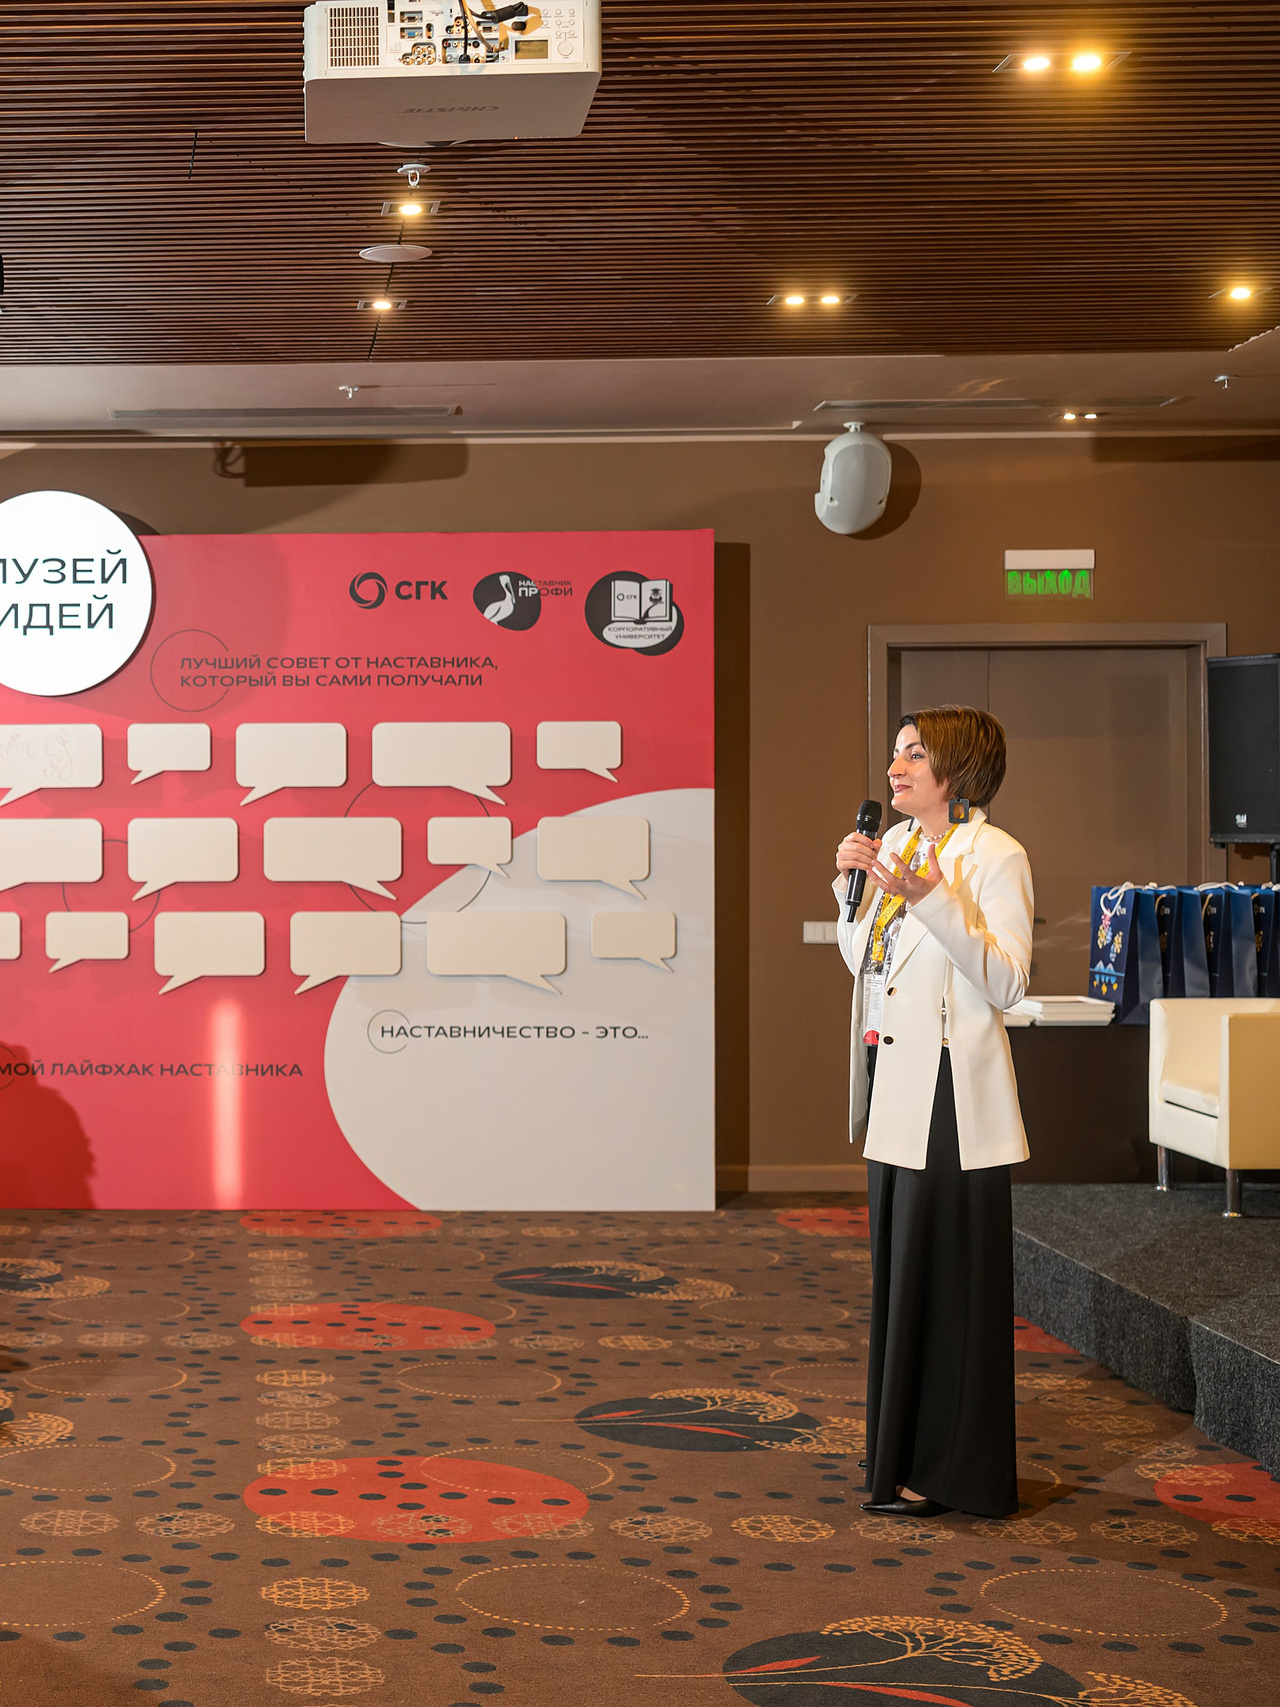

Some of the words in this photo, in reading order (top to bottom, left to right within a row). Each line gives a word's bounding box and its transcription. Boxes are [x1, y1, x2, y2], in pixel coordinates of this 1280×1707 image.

[402, 105, 500, 114] CHRISTIE
[394, 580, 449, 600] СГК
[518, 579, 572, 587] НАСТАВНИК
[1007, 569, 1091, 598] ВЫХОД
[518, 587, 573, 598] ПРОФИ
[179, 654, 262, 670] ЛУЧШИЙ
[266, 656, 332, 669] СОВЕТ
[335, 656, 363, 669] ОТ
[366, 656, 499, 671] НАСТАВНИКА,
[179, 672, 277, 688] КОТОРЫЙ
[282, 675, 311, 687] ВЫ
[315, 674, 372, 687] САМИ
[376, 674, 483, 687] ПОЛУЧАЛИ
[882, 900, 898, 920] 2026
[380, 1025, 576, 1039] НАСТАВНИЧЕСТВО
[50, 1060, 154, 1076] ЛАЙФХАК
[159, 1063, 304, 1077] НАСТАВНИКА
